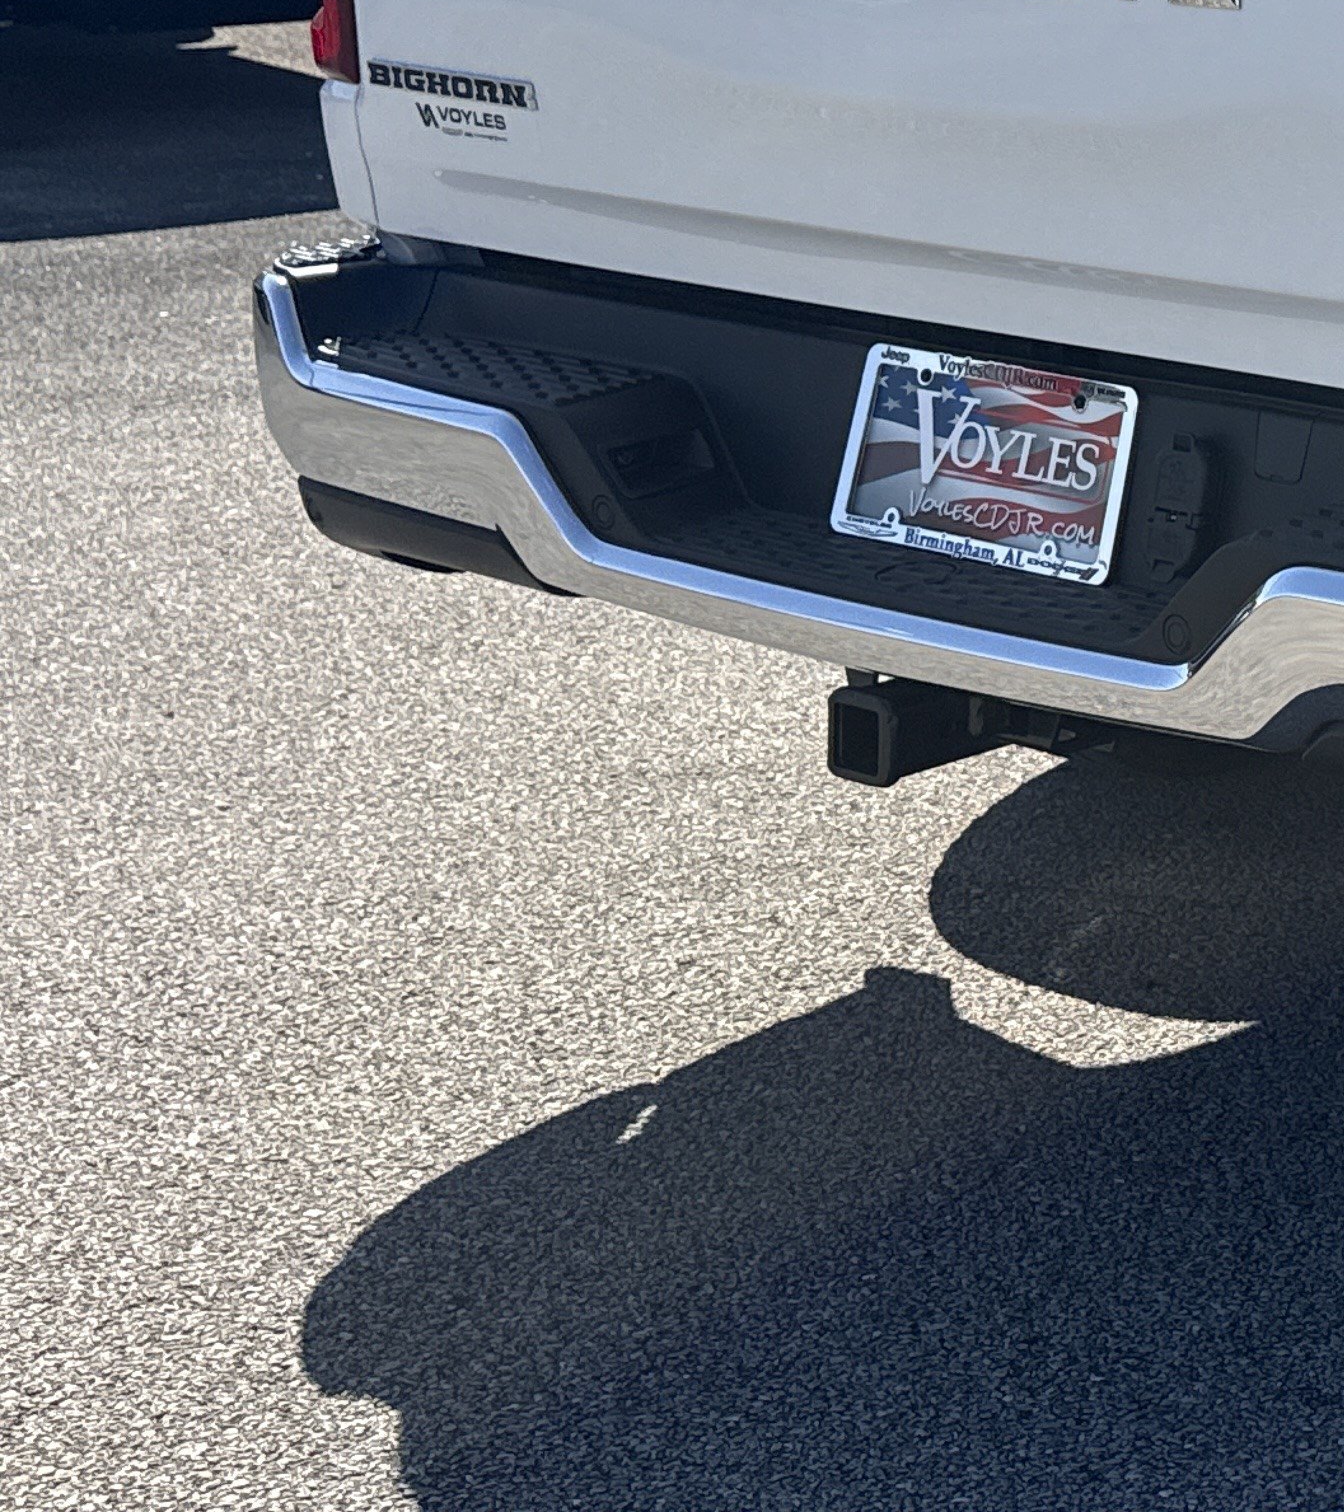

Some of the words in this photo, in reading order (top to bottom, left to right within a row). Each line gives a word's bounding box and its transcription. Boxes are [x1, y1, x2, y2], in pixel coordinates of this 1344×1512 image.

[368, 61, 528, 107] BIGHORN
[436, 105, 507, 130] VOYLES
[882, 346, 910, 364] Jeep
[939, 354, 1058, 391] VoylesCDJR.com
[916, 388, 1100, 490] VOYLES
[904, 527, 999, 565] Birmingham,
[1005, 547, 1025, 568] AL
